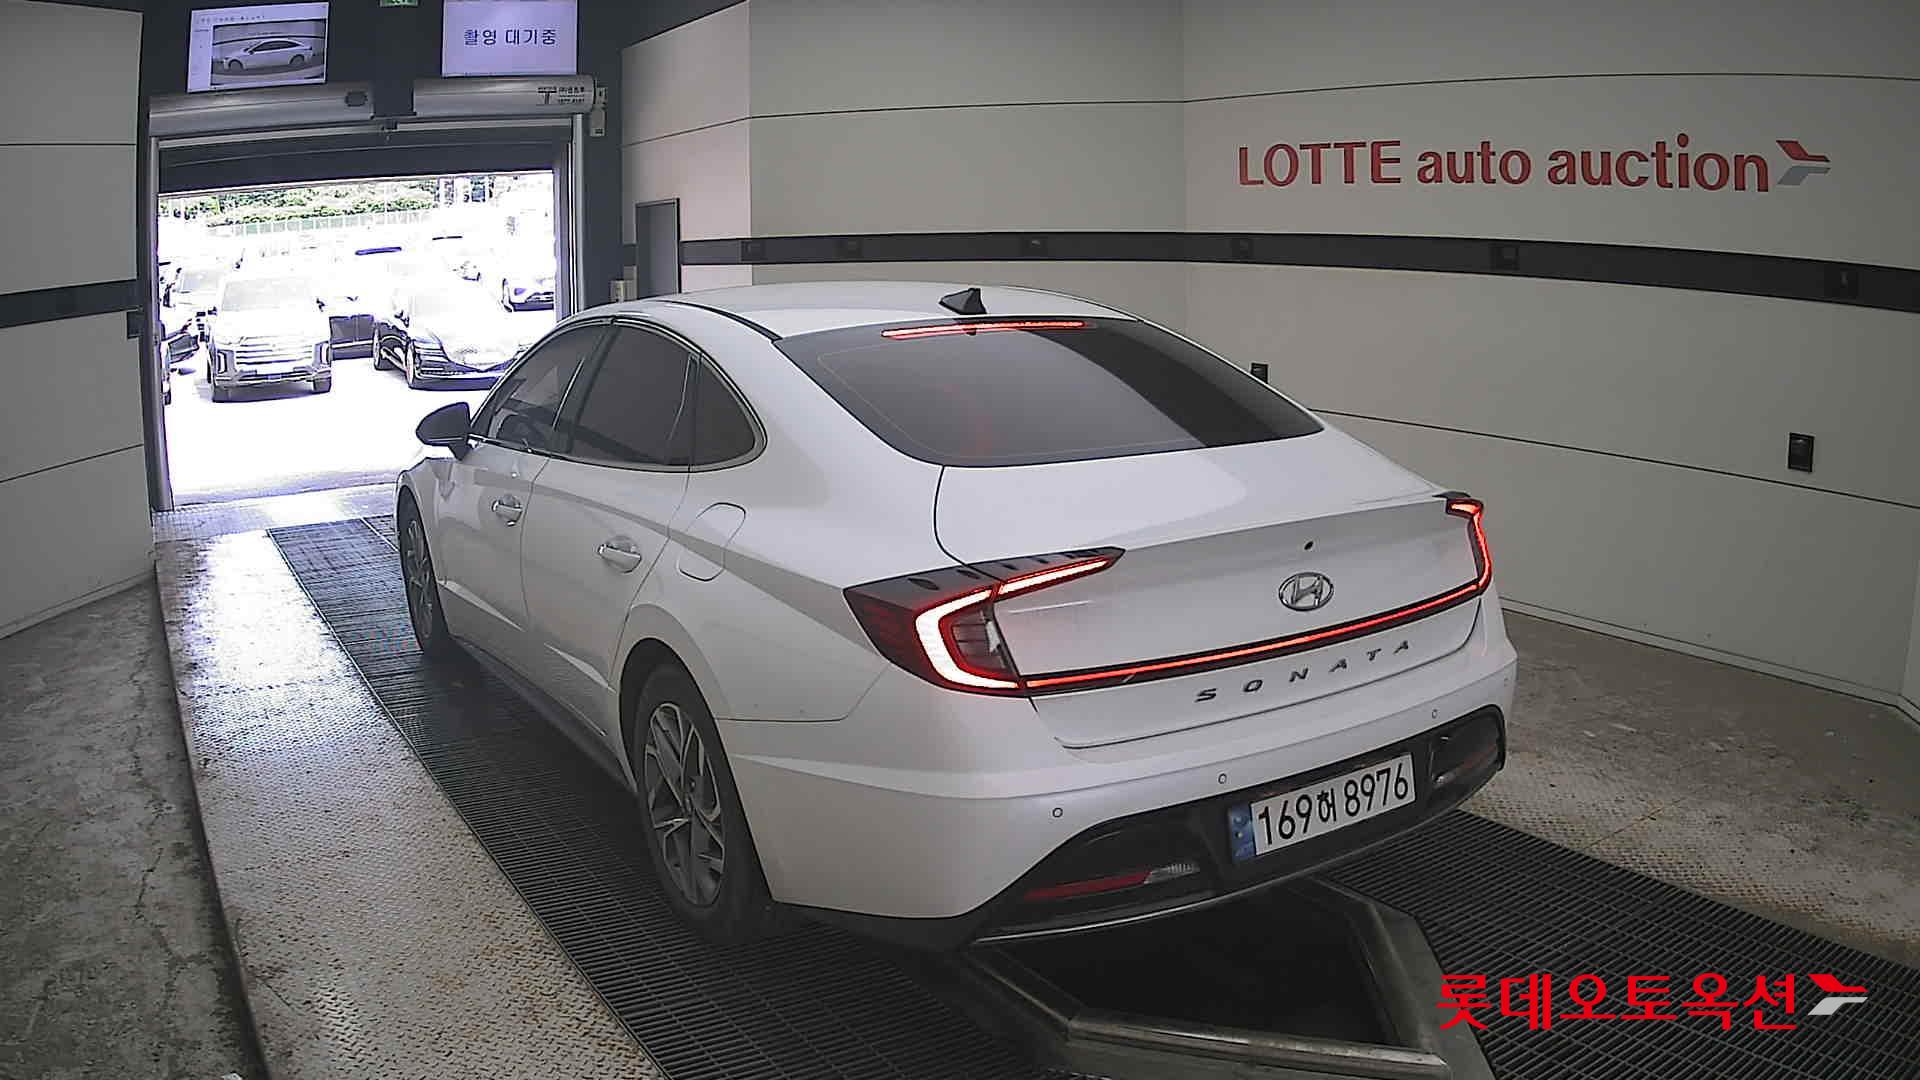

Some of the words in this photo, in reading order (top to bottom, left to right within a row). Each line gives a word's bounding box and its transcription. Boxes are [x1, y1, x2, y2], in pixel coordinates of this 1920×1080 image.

[464, 29, 497, 46] 촬영
[505, 29, 557, 46] 대기중
[1239, 140, 1401, 186] LOTTE
[1416, 140, 1532, 186] auto
[1547, 132, 1770, 192] auction
[1194, 640, 1409, 703] SONATA
[1258, 786, 1337, 845] 169허
[1343, 763, 1408, 818] 8976
